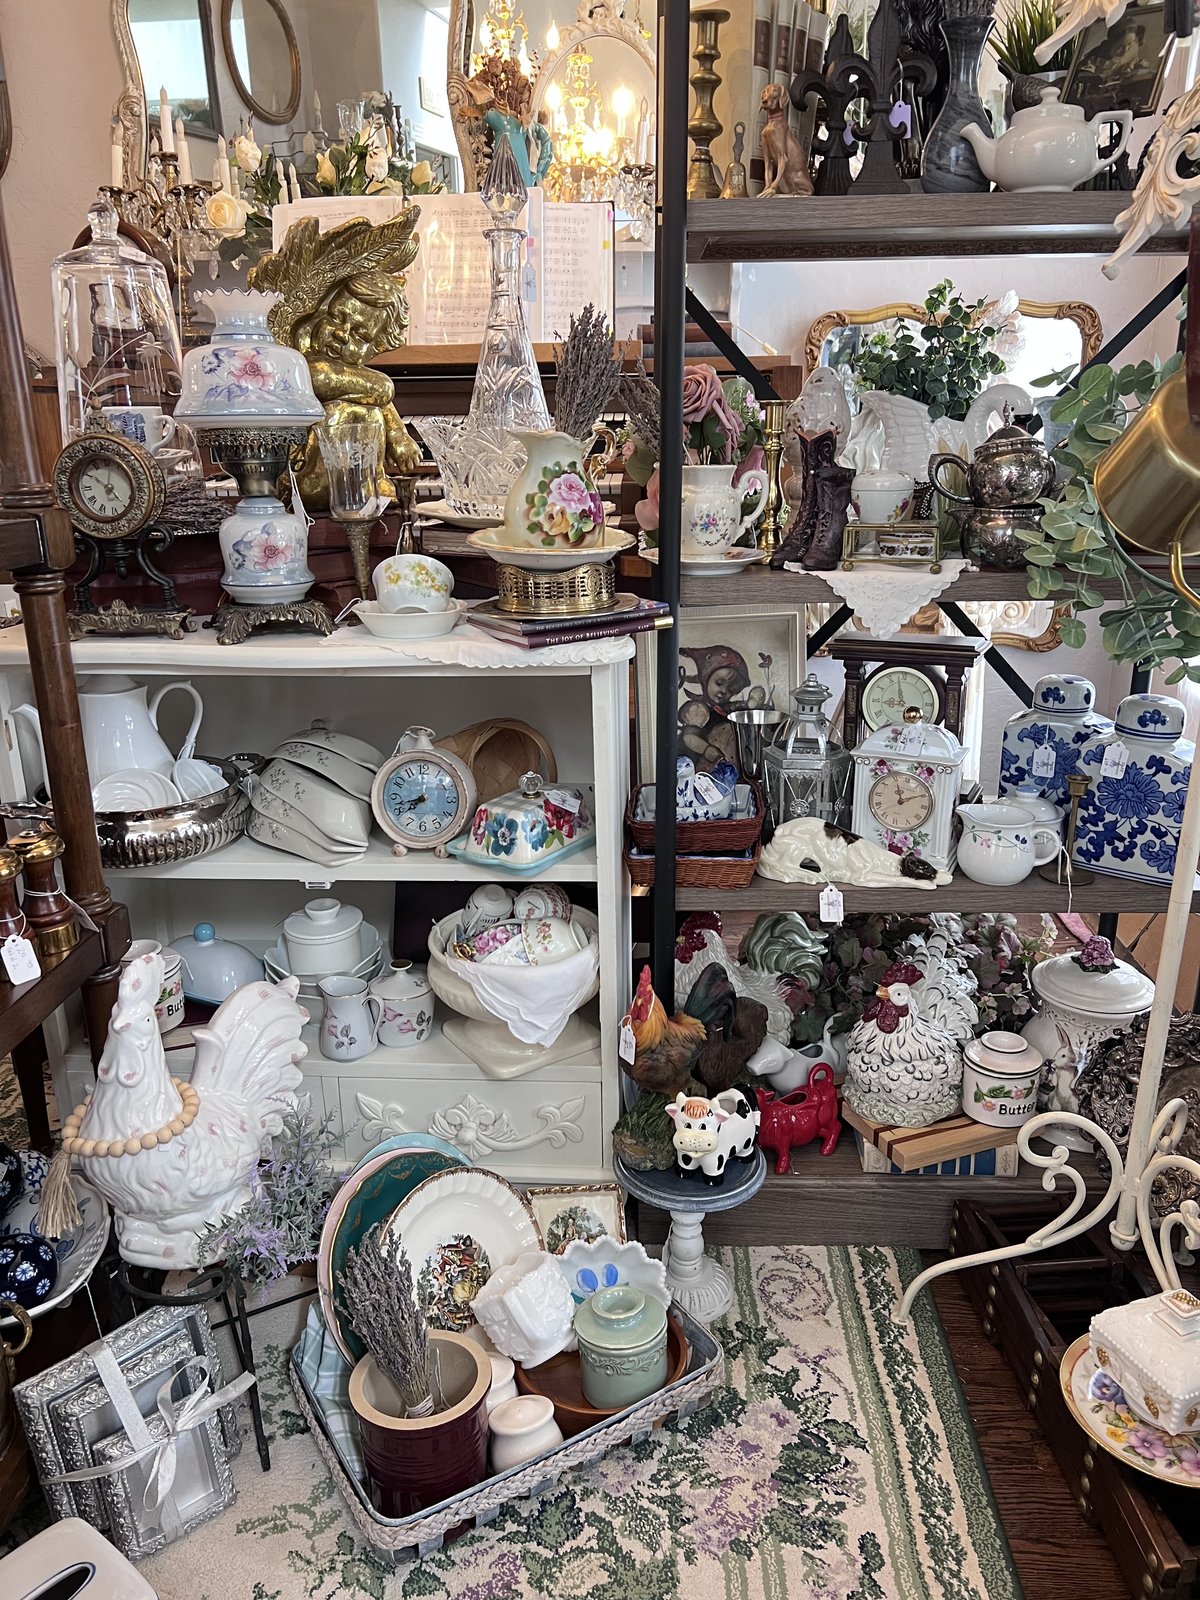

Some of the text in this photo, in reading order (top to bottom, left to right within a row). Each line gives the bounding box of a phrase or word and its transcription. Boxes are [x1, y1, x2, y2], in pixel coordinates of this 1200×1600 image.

[545, 637, 559, 645] THE
[561, 635, 574, 643] JOY
[586, 628, 619, 639] BELIEVING
[404, 767, 415, 778] 11
[419, 764, 430, 775] 12
[393, 776, 406, 789] 10
[446, 796, 456, 804] 3
[443, 810, 453, 819] 4
[406, 817, 415, 827] 7
[419, 820, 427, 832] 6
[431, 818, 442, 830] 5
[999, 1101, 1035, 1115] Butter
